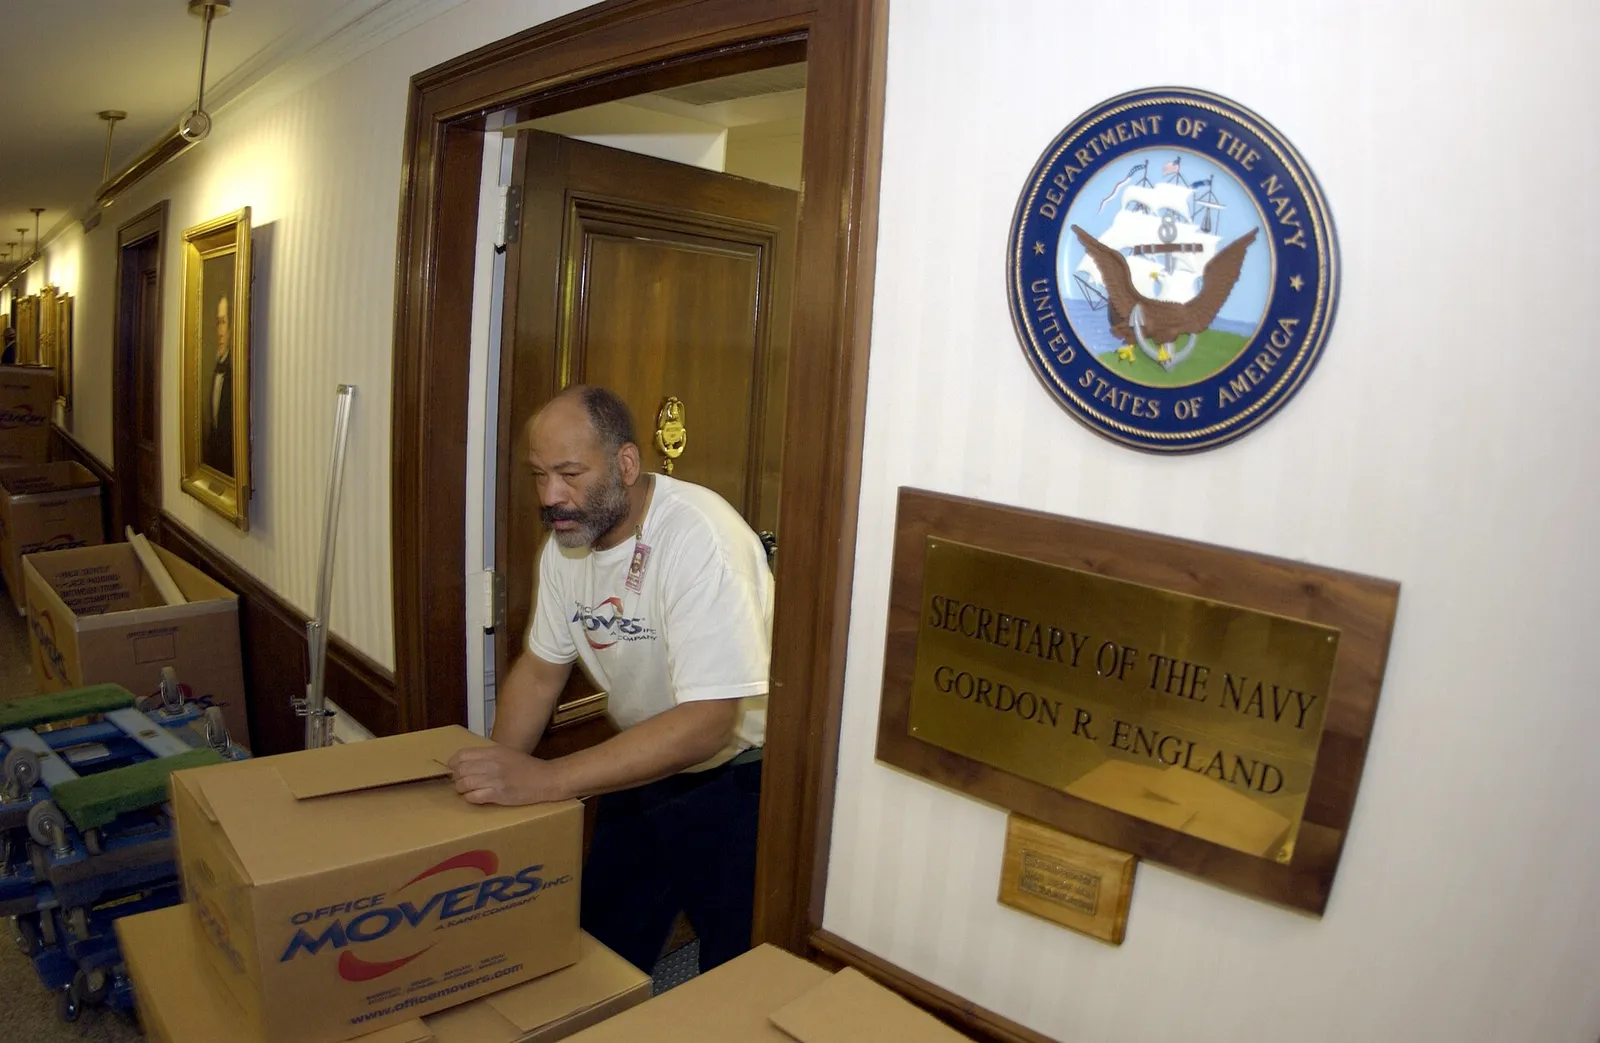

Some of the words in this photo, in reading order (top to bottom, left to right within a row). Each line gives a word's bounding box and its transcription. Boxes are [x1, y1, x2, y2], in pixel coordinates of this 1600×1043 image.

[1038, 115, 1162, 220] DEPARTMENT
[1175, 117, 1208, 140] OF
[1217, 128, 1263, 171] THE
[1259, 173, 1308, 250] NAVY
[1030, 278, 1077, 367] UNITED
[1078, 368, 1161, 420] STATES
[1174, 397, 1205, 420] OF
[1216, 316, 1300, 409] AMERICA
[928, 594, 1091, 669] SECRETARY
[1096, 640, 1138, 682] OF
[1148, 652, 1211, 703] THE
[1219, 672, 1319, 730] NAVY
[933, 664, 1063, 728] GORDON
[1071, 708, 1097, 741] R.
[1109, 718, 1284, 795] ENGLAND
[279, 863, 545, 963] MOVERS
[289, 892, 387, 926] OFFICE
[482, 894, 541, 917] COMPANY
[350, 962, 524, 1025] www.officemovers.com
